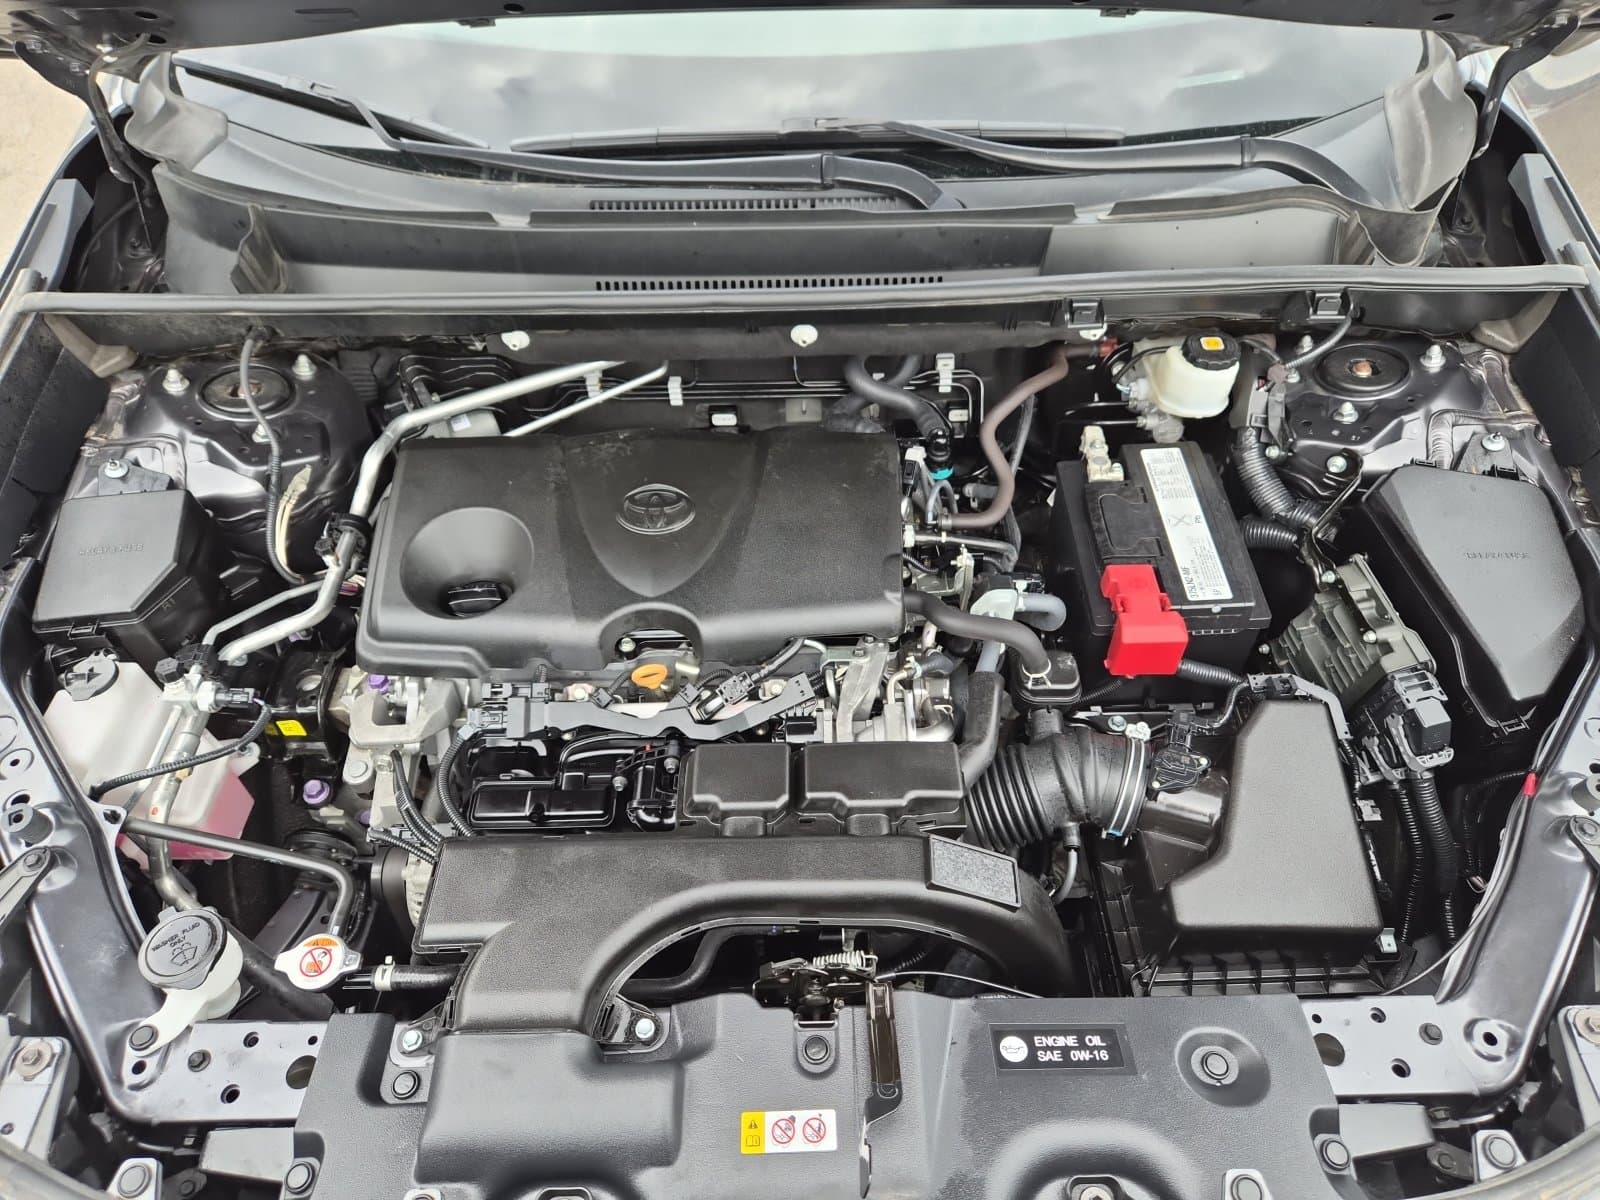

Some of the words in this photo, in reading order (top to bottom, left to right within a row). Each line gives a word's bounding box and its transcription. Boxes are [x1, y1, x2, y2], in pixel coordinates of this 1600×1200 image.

[151, 933, 179, 952] WASHER
[182, 922, 201, 935] FLUID
[169, 935, 186, 948] ONLY
[1033, 1035, 1079, 1047] ENGINE
[1084, 1035, 1107, 1047] OIL
[1037, 1050, 1064, 1062] SAE
[1069, 1050, 1109, 1061] 0W-16
